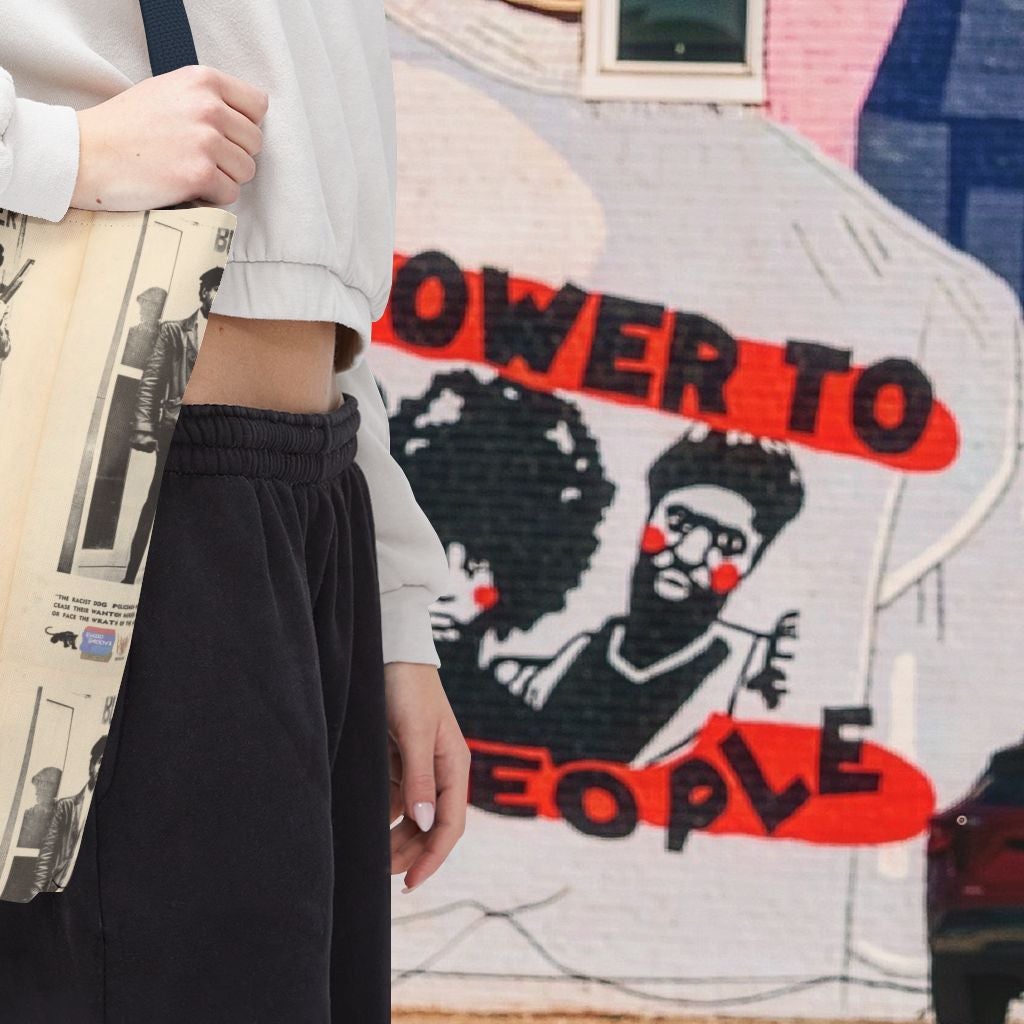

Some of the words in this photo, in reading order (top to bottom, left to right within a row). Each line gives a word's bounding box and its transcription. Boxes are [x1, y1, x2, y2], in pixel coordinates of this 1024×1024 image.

[390, 250, 740, 417] OWER
[784, 339, 934, 455] TO
[54, 602, 70, 610] CEASE
[468, 707, 882, 853] EOPLE
